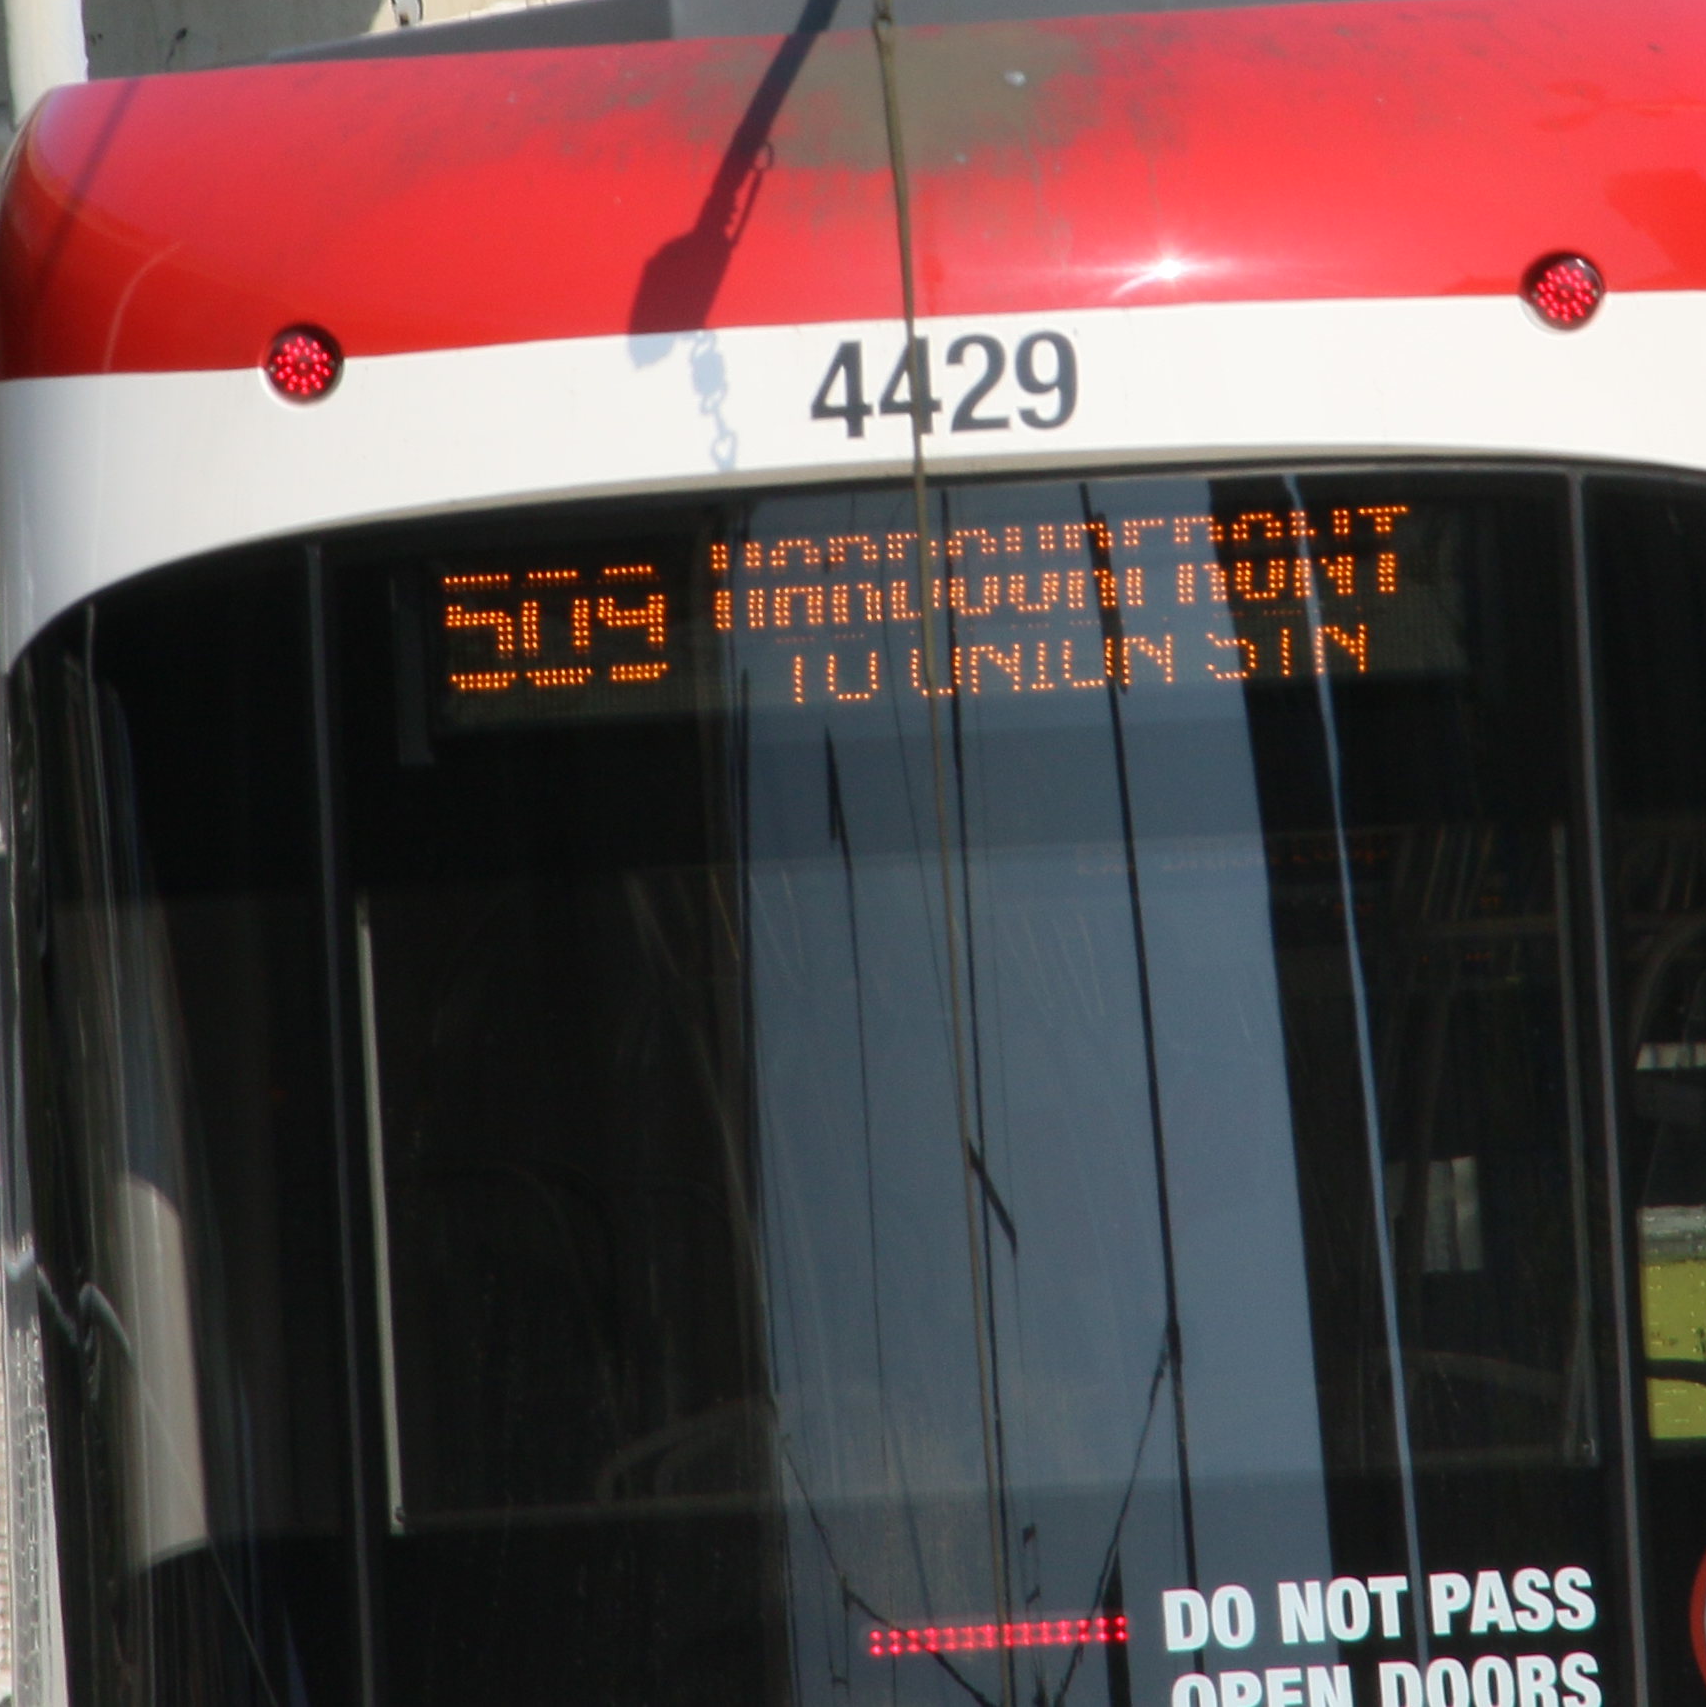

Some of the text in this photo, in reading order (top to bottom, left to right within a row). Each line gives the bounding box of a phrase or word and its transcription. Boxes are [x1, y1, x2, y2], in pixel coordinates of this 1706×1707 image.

[810, 328, 1079, 440] 4429
[444, 565, 669, 689] 509
[910, 634, 1174, 696] UNION
[1162, 1566, 1597, 1653] DO NOT PASS
[1379, 1650, 1603, 1707] DOORS
